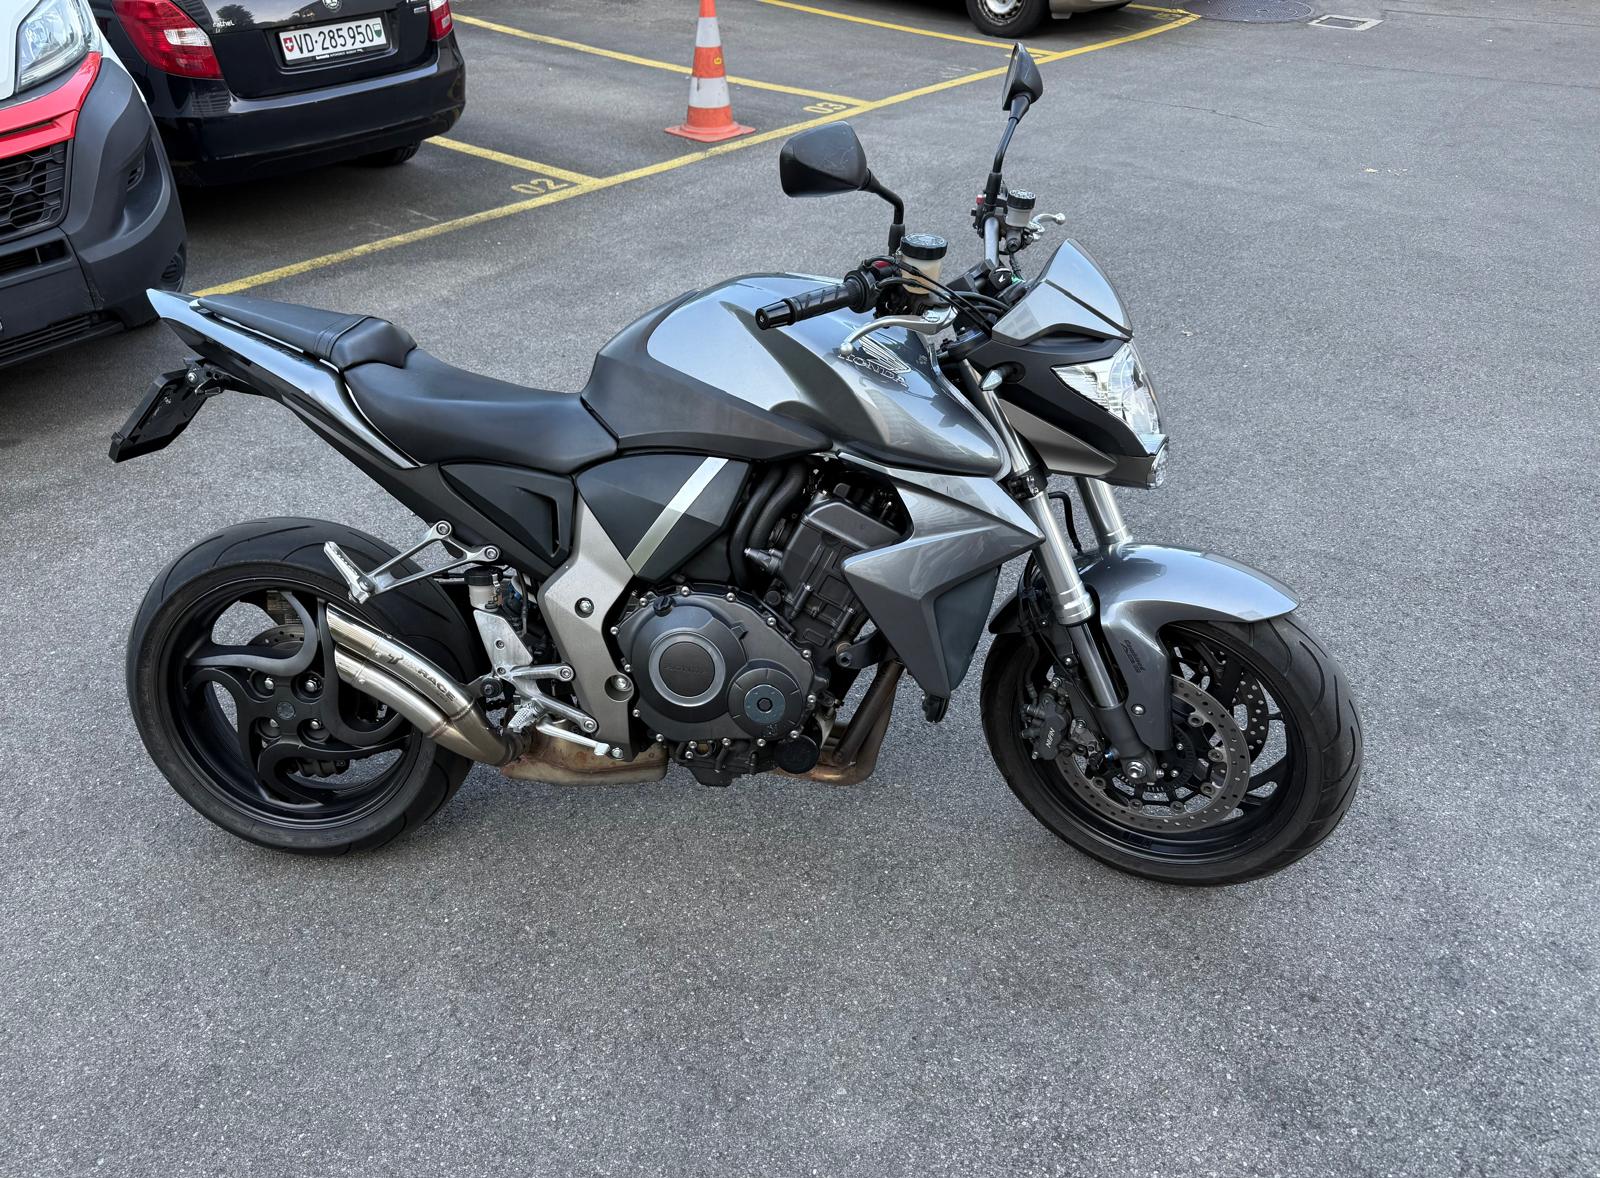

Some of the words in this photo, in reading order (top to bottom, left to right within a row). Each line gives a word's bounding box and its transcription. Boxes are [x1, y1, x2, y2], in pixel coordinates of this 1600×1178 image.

[802, 101, 847, 114] 03
[511, 178, 568, 194] 02
[838, 352, 909, 388] HONDA
